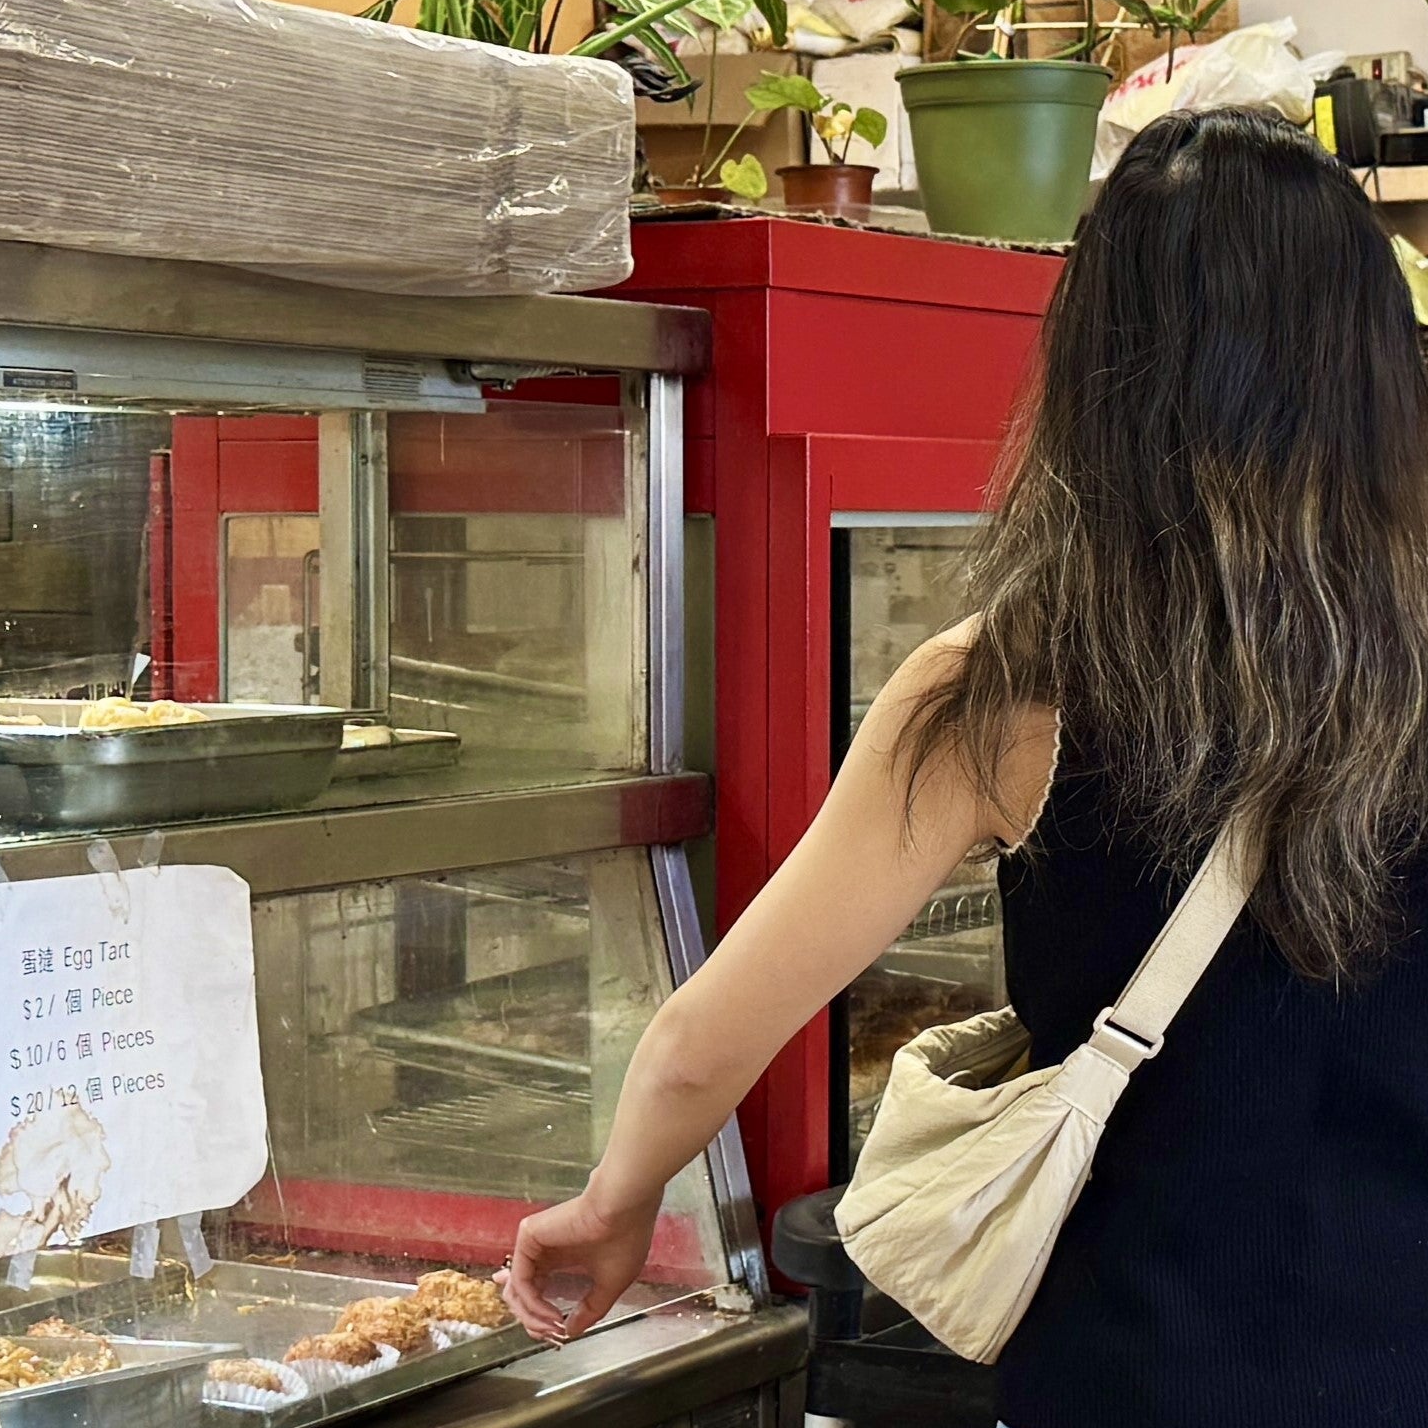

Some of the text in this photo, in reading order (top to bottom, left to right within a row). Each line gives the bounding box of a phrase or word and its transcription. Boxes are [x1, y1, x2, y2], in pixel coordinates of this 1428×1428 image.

[64, 945, 93, 970] Egg
[99, 941, 131, 961] Tart
[65, 988, 82, 1015] 個
[92, 986, 134, 1009] Piece
[75, 1032, 94, 1060] 個
[101, 1027, 155, 1052] Pieces
[85, 1076, 104, 1103] 個
[113, 1071, 166, 1095] Pieces
